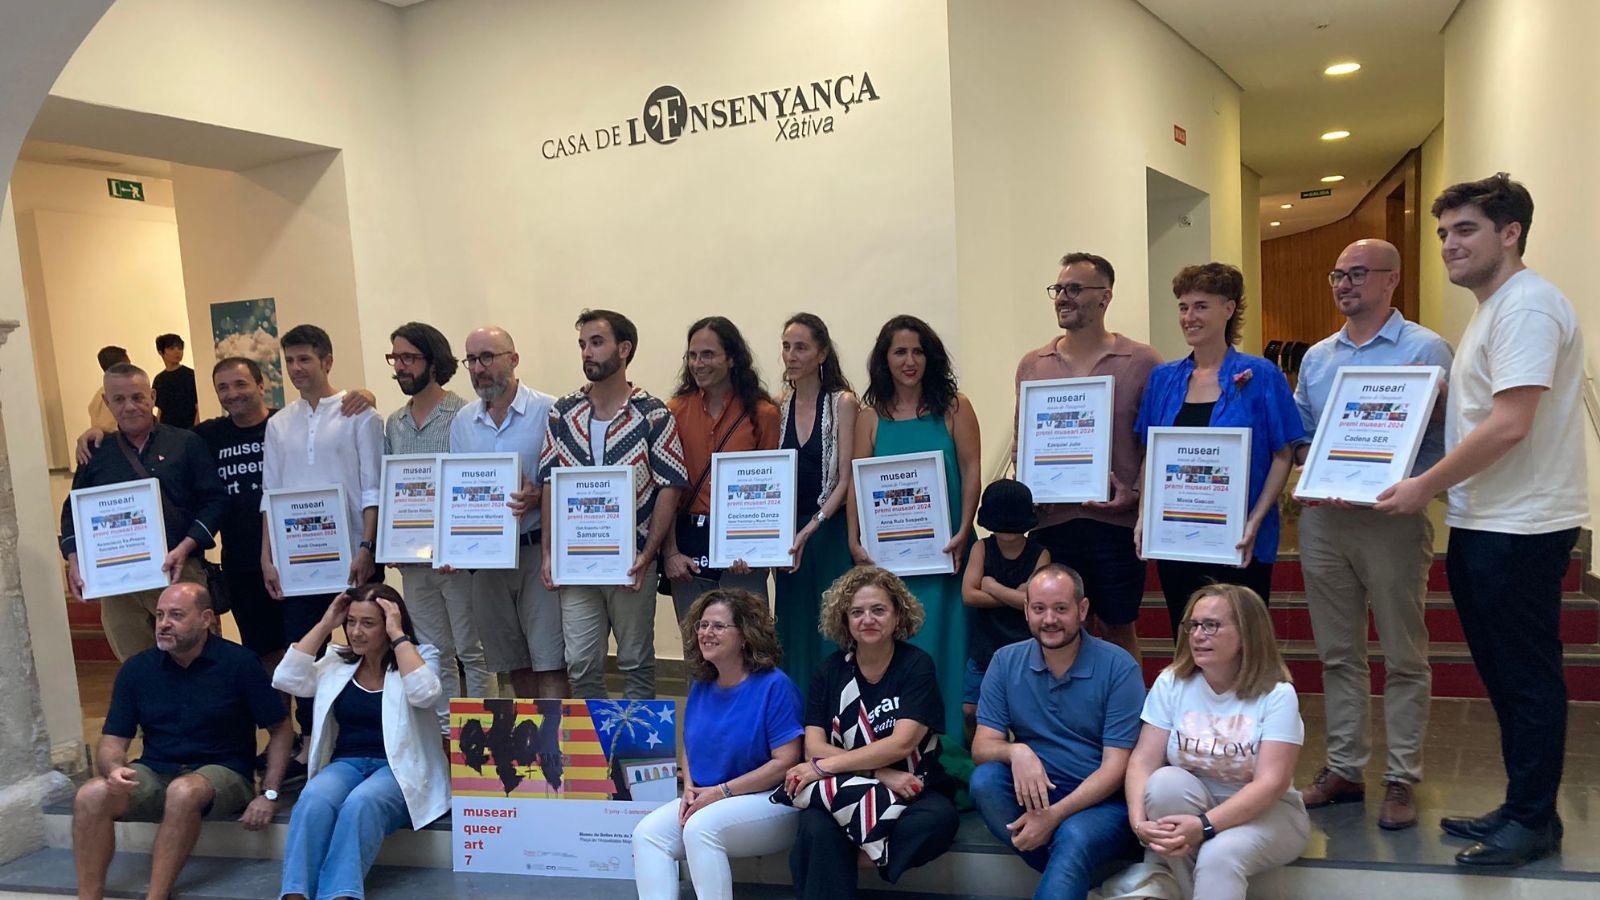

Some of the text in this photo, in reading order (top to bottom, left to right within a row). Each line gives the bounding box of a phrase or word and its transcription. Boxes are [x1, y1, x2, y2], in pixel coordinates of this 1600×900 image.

[776, 114, 834, 142] Xàtiva
[541, 133, 591, 160] CASA
[595, 125, 622, 150] DE
[1362, 384, 1406, 393] museari
[1047, 393, 1086, 403] museari
[1344, 435, 1388, 444] Cadena SER
[1177, 446, 1220, 456] museari
[403, 466, 432, 475] museari
[461, 469, 496, 478] museari
[737, 466, 773, 476] museari
[880, 469, 918, 481] museari
[576, 480, 611, 488] museari
[98, 495, 135, 507] museari
[291, 500, 324, 510] museari
[463, 807, 518, 818] museari
[463, 824, 502, 835] queer
[464, 839, 484, 850] art
[464, 855, 473, 866] 7
